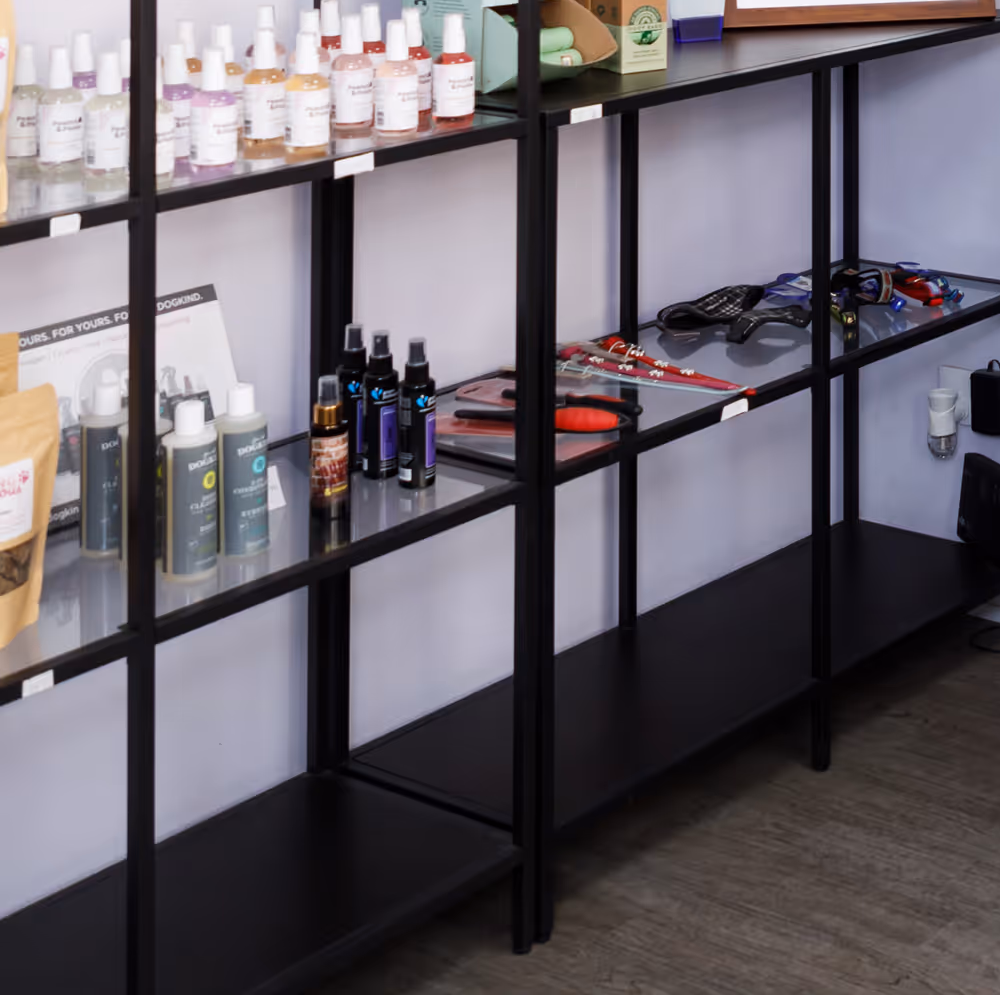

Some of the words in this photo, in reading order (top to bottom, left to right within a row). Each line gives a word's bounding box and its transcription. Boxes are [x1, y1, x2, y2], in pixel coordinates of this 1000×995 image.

[19, 333, 51, 347] OURS.
[52, 326, 74, 339] FOR
[75, 316, 113, 332] YOURS.
[114, 312, 129, 322] FO
[157, 292, 204, 311] DOGKIND.
